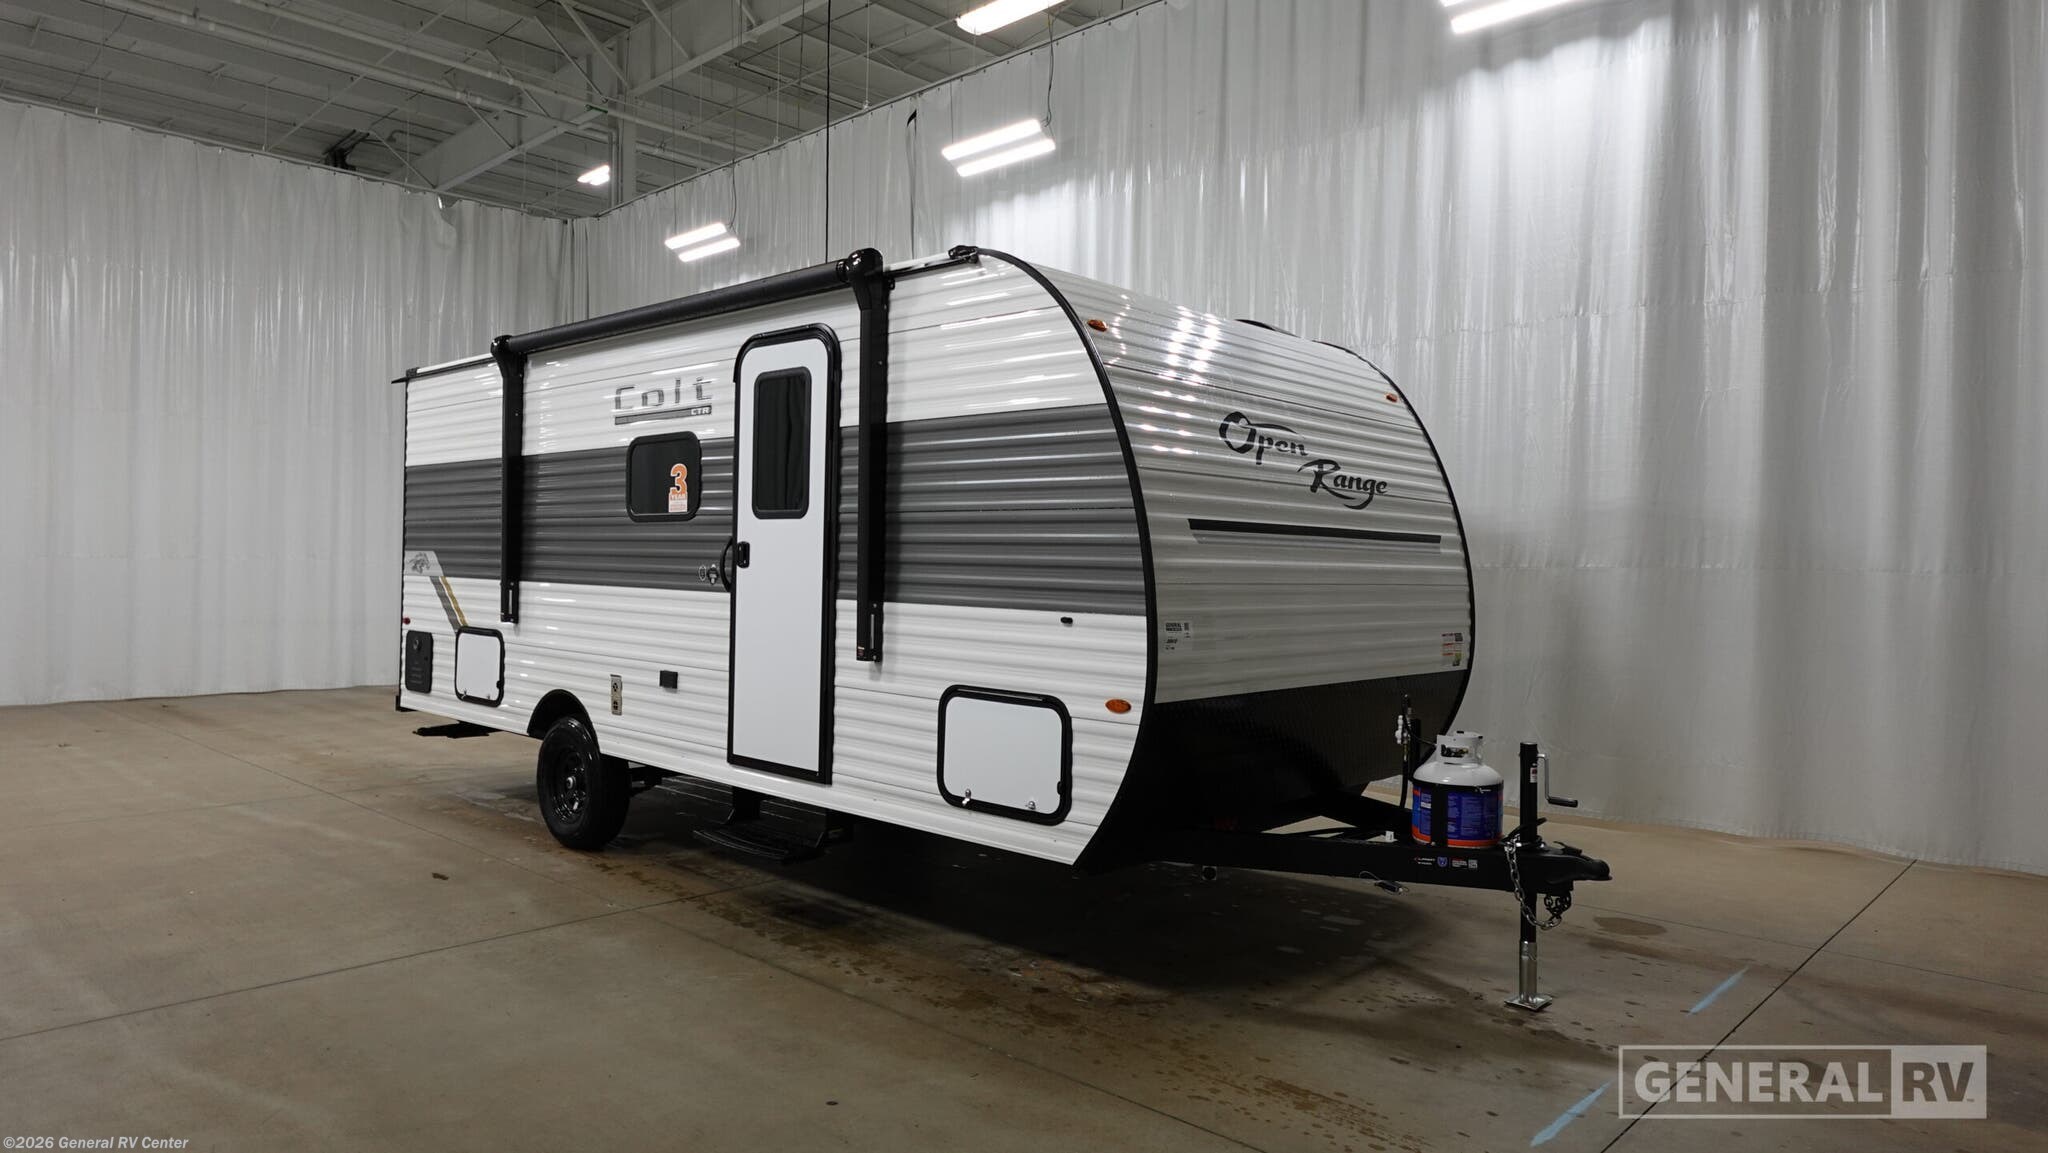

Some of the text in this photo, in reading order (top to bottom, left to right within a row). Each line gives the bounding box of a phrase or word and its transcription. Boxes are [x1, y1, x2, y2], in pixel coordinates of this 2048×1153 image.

[614, 376, 712, 410] Colt
[690, 406, 710, 416] CTR
[1218, 411, 1308, 465] Open
[670, 463, 687, 494] 3
[1298, 459, 1388, 510] Range
